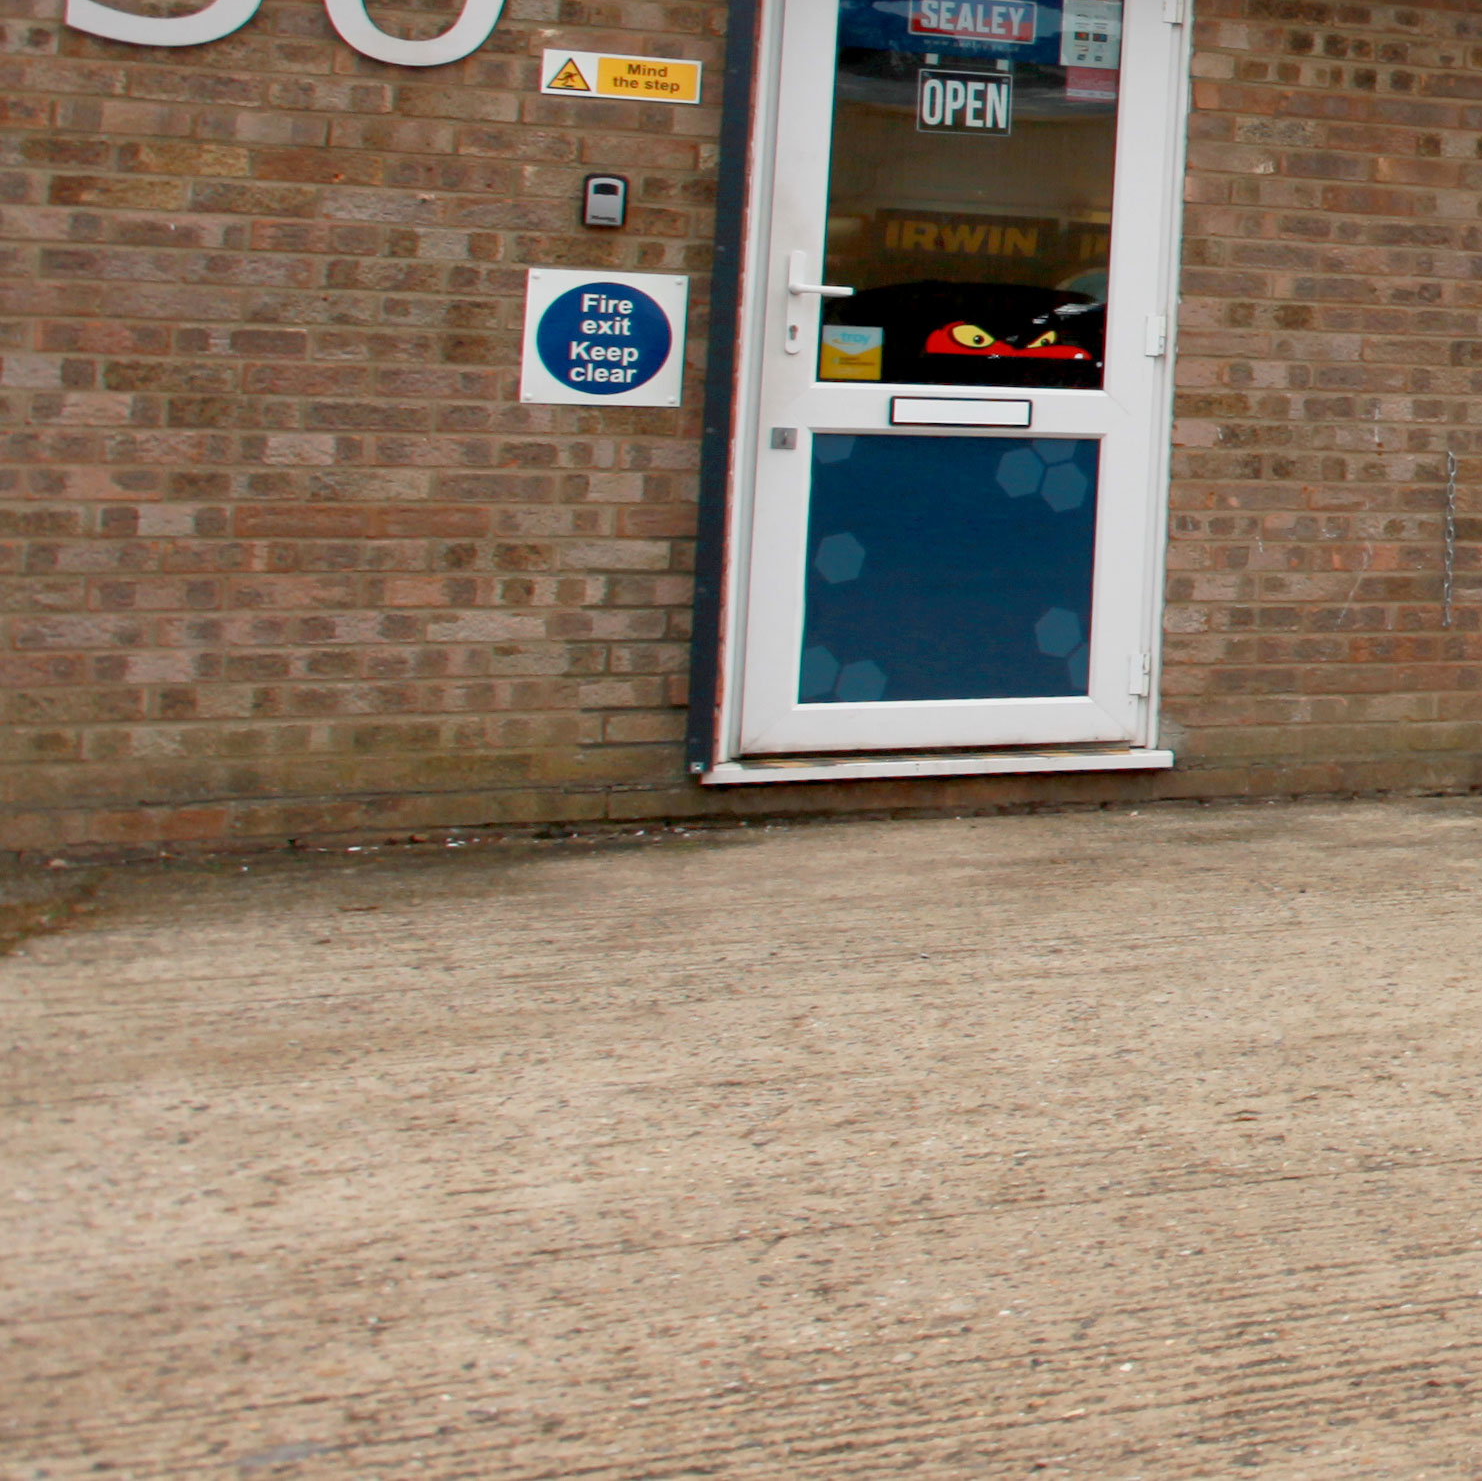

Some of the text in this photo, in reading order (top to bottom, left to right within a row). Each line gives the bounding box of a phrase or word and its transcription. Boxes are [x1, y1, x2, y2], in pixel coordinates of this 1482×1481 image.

[627, 64, 668, 77] Mind
[613, 76, 681, 93] the step
[922, 78, 1008, 129] OPEN
[886, 220, 1037, 257] IRWIN
[582, 294, 633, 314] Fire
[581, 314, 631, 337] exit
[569, 341, 639, 366] Keep
[569, 362, 637, 384] clear
